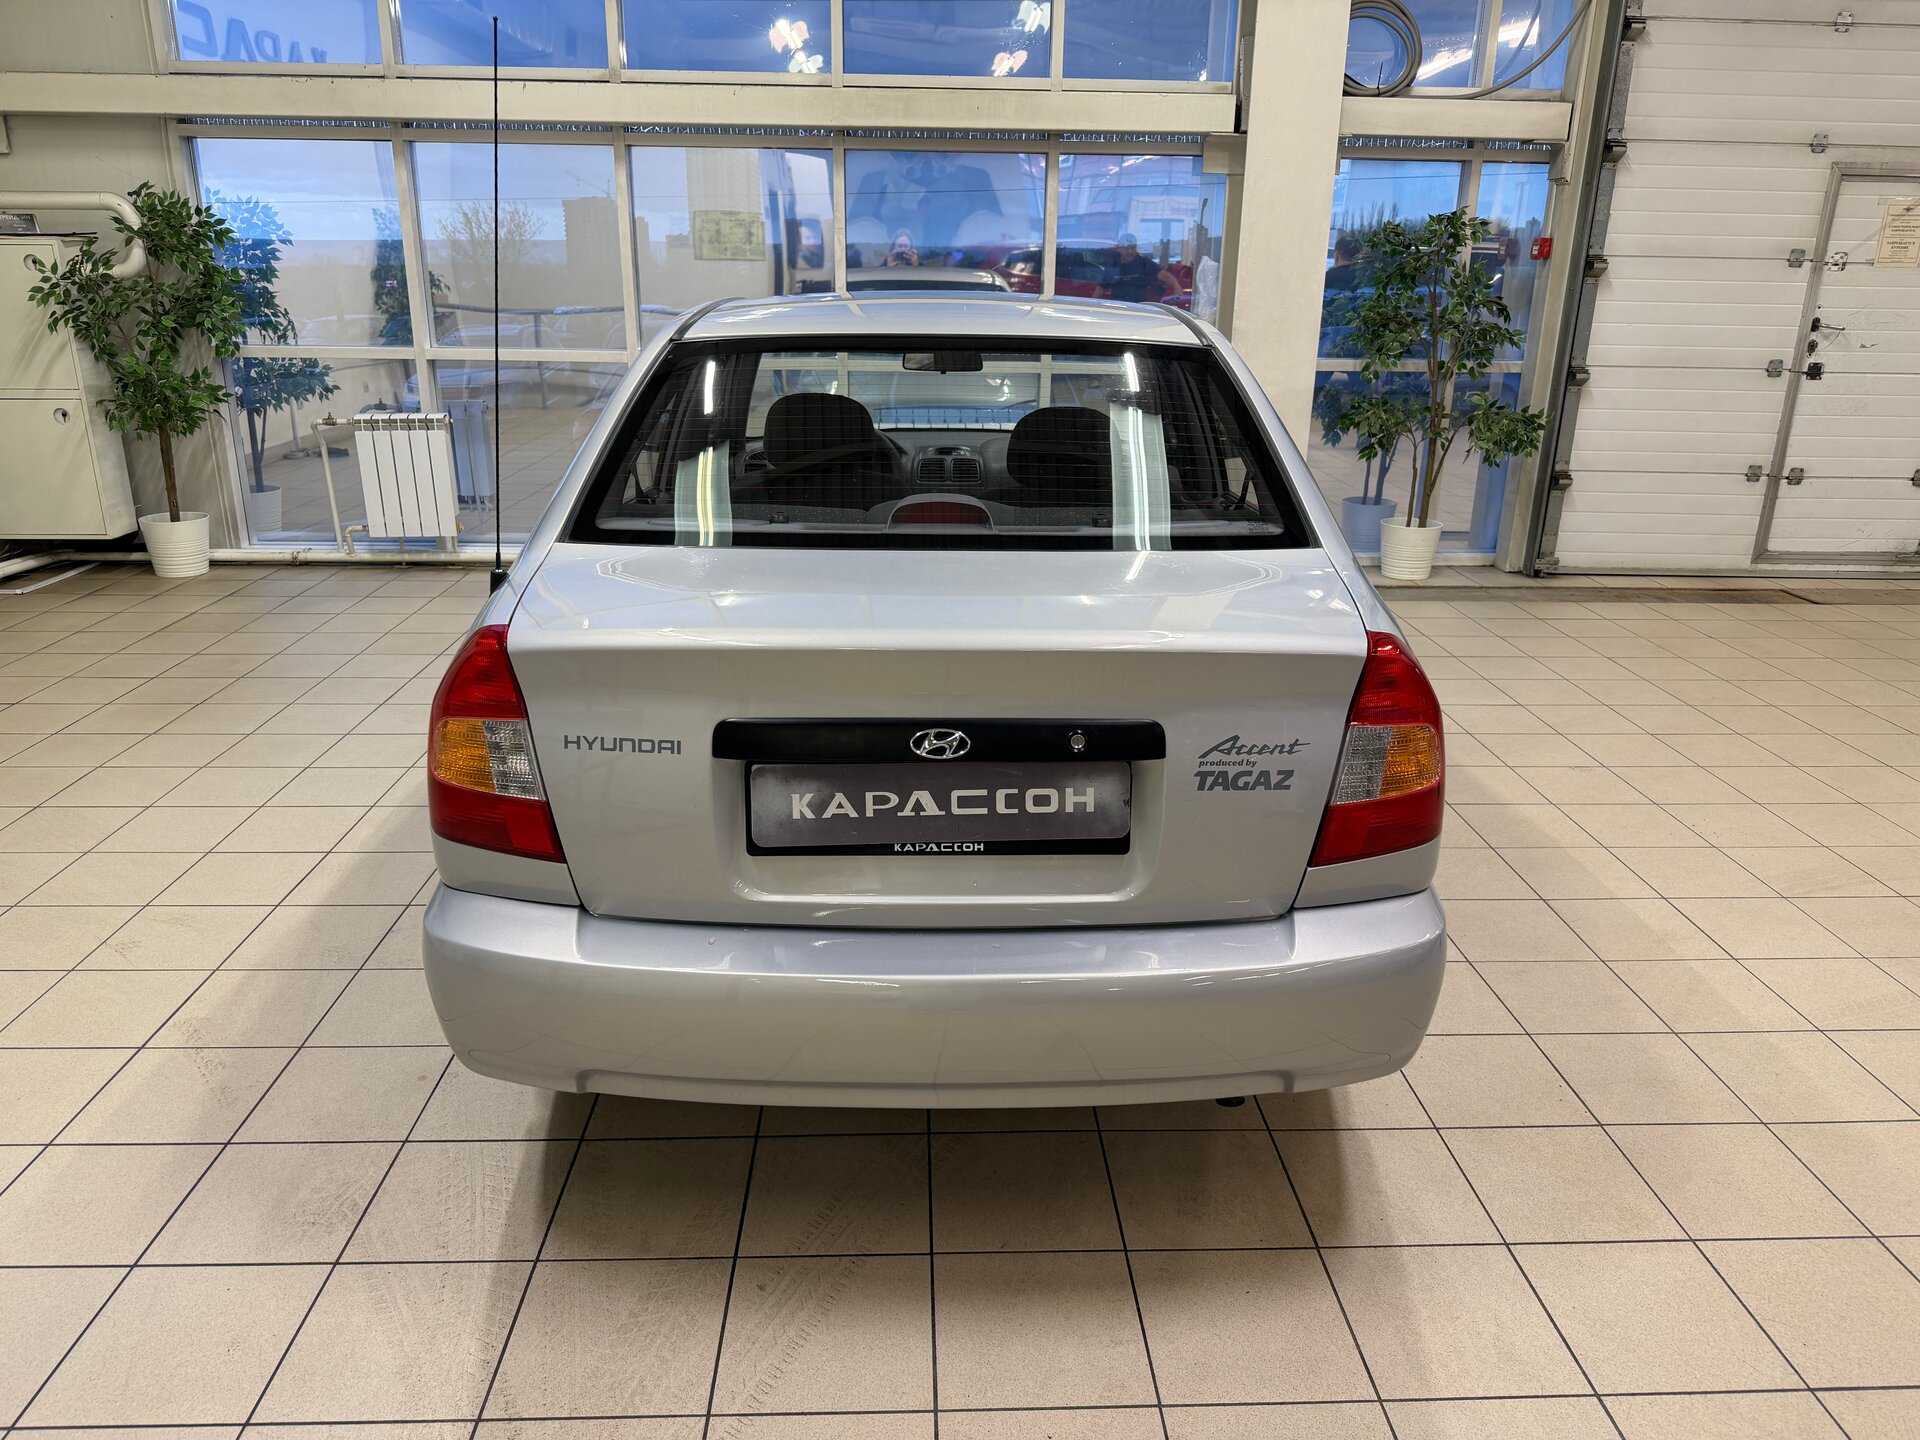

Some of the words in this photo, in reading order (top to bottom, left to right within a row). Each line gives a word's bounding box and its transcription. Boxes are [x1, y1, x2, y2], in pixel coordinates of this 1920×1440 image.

[563, 735, 682, 755] HYUNDAI
[1197, 734, 1311, 759] Accent
[1198, 758, 1244, 768] produced
[1245, 758, 1257, 768] by
[1193, 769, 1295, 791] TAGAZ
[791, 787, 1095, 820] КАРАССОН
[894, 842, 984, 852] КАРАССОН
